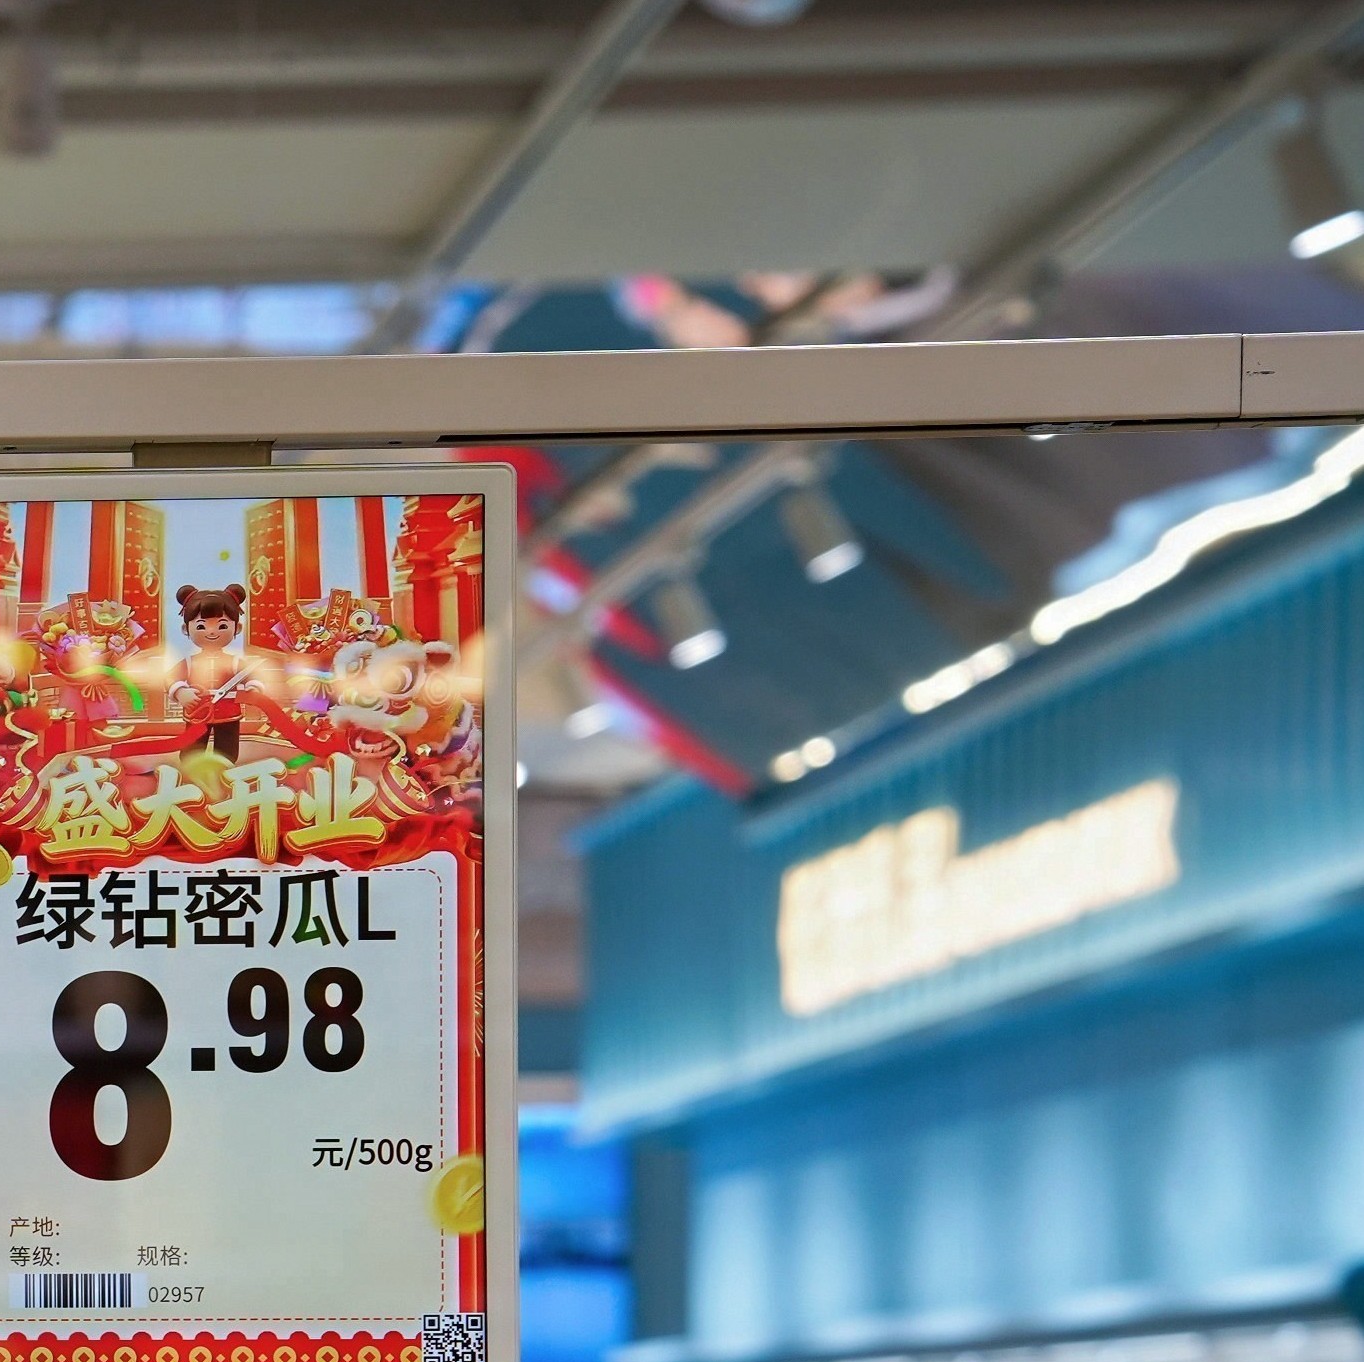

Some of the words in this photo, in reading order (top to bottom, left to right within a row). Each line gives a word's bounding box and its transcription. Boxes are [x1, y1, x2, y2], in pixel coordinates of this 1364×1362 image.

[38, 752, 387, 864] 盛大开业
[15, 870, 397, 950] 绿钻密瓜L
[312, 1137, 434, 1172] 元/500g
[148, 1286, 205, 1303] 02957
